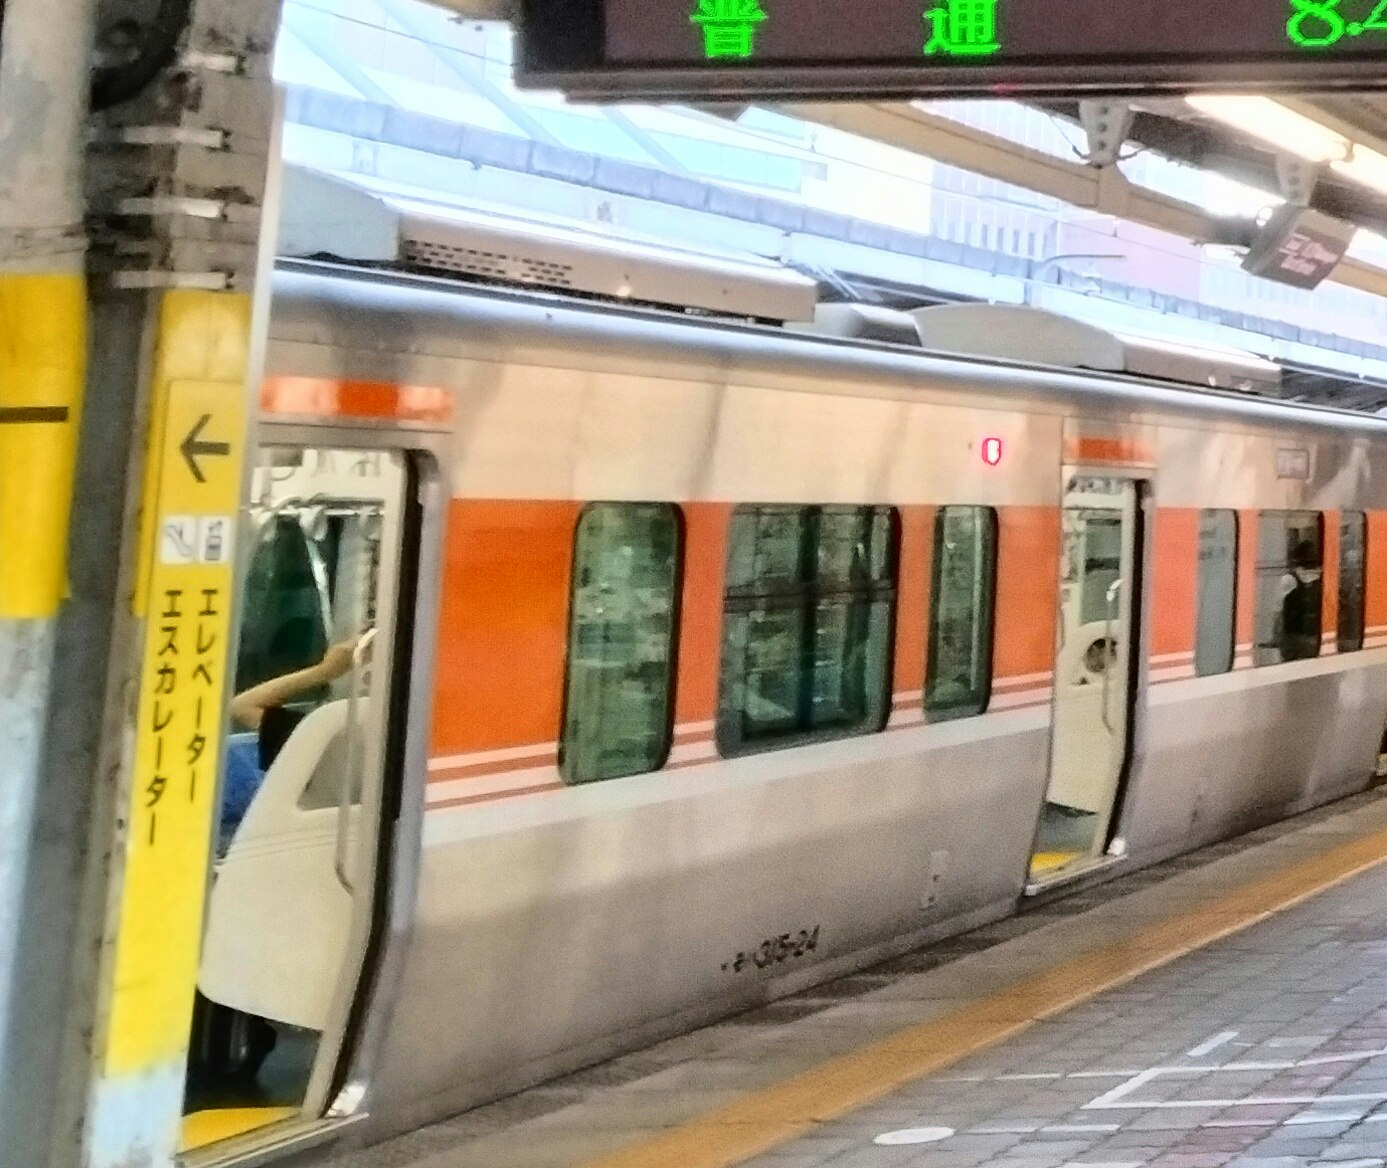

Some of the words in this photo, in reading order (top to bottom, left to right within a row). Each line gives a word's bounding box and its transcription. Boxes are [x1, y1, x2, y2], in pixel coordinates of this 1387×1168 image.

[146, 589, 184, 847] エスカレーター
[188, 588, 219, 804] エレベーター
